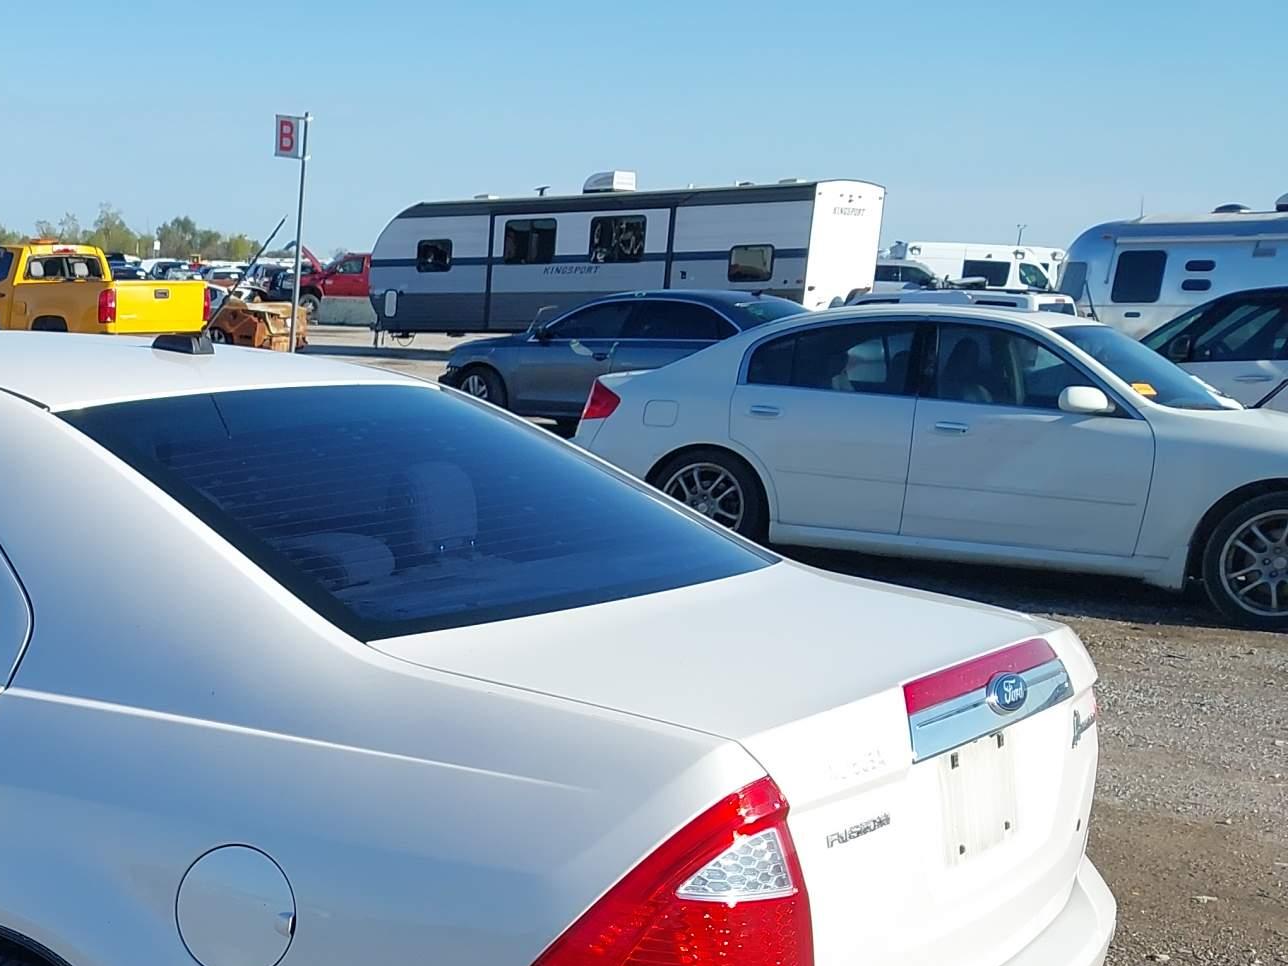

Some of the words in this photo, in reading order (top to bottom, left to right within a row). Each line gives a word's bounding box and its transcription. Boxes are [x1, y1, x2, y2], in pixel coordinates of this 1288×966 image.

[279, 120, 294, 152] B
[543, 264, 601, 275] KINGSPORT
[1003, 679, 1025, 704] Ford
[826, 812, 891, 849] FUSION
